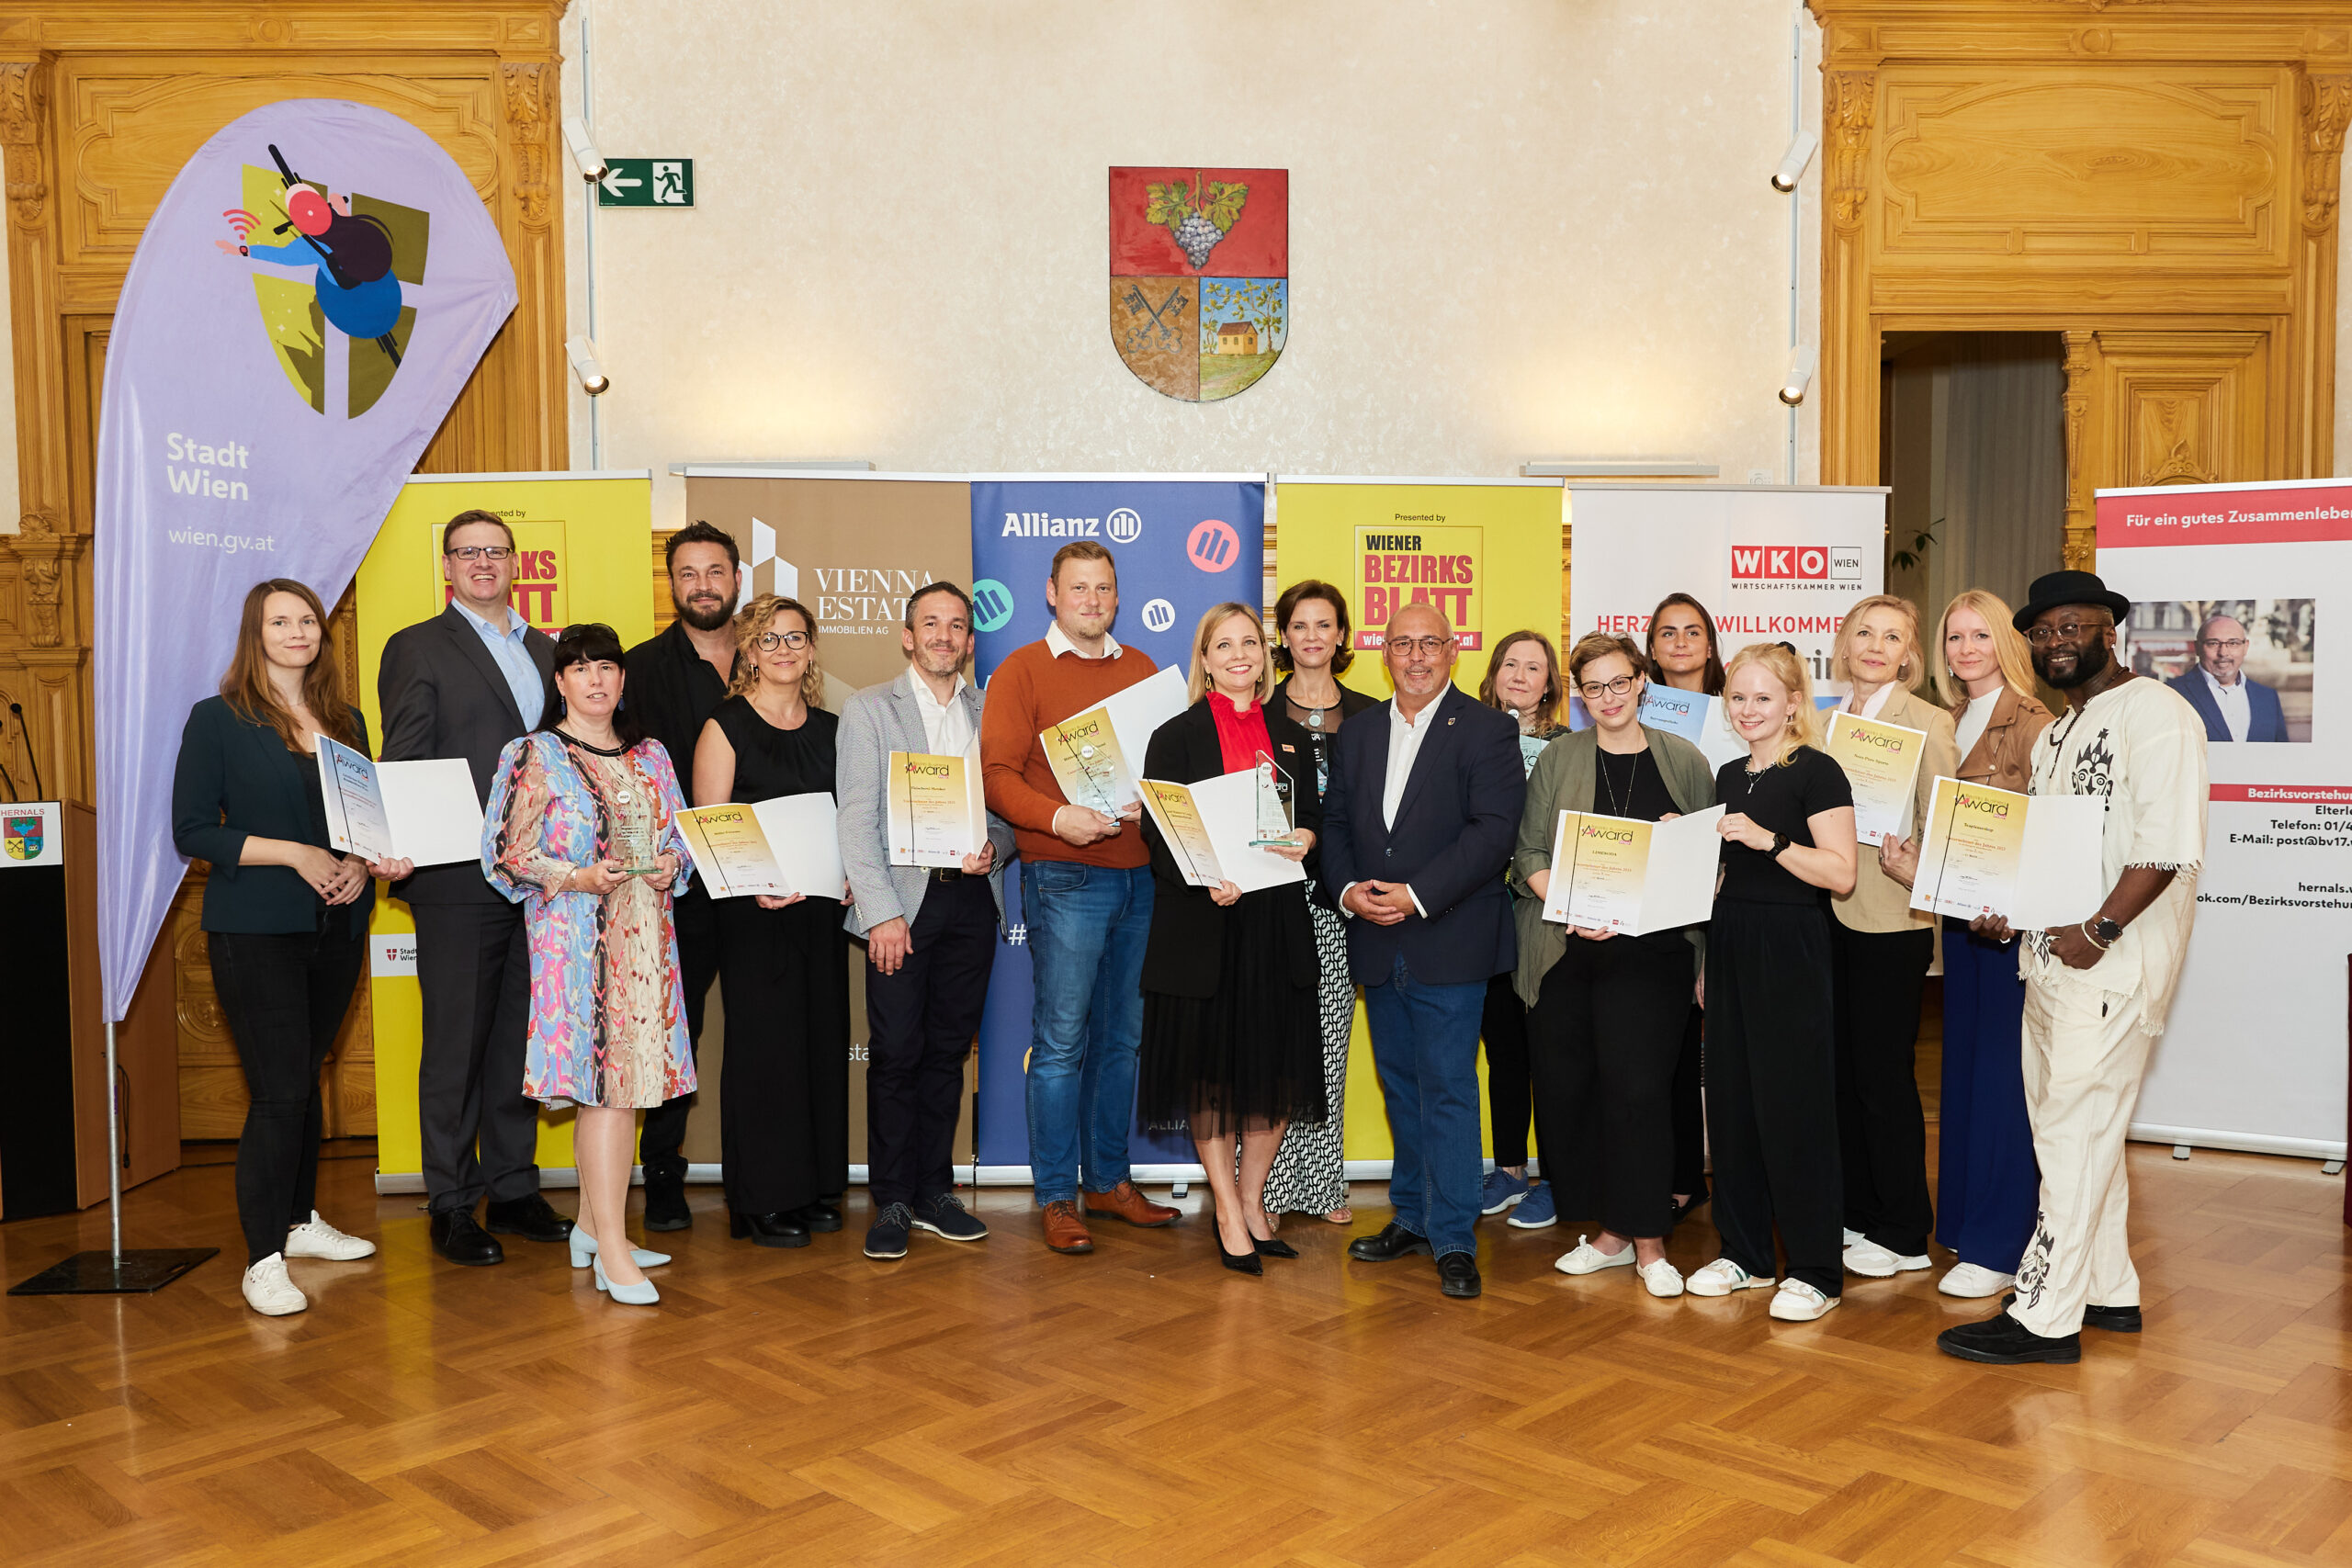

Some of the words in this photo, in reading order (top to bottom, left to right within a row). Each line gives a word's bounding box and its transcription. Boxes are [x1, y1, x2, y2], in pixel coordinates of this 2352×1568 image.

[166, 432, 249, 469] Stadt
[166, 465, 249, 501] Wien
[515, 510, 526, 519] by
[1395, 513, 1434, 522] Presented
[1436, 513, 1446, 523] by
[2126, 513, 2151, 527] Für
[2154, 513, 2177, 526] ein
[2181, 512, 2224, 529] gutes
[2228, 506, 2352, 524] Zusammenlebe
[1001, 513, 1100, 537] Allianz
[168, 525, 275, 554] wien.gv.at
[1365, 535, 1422, 551] WIENER
[1364, 554, 1474, 584] BEZIRKS
[1733, 549, 1825, 575] WKO
[1834, 558, 1860, 568] WIEN
[813, 568, 934, 593] VIENNA
[1732, 582, 1836, 591] WIRTSCHAFTSKAMMER
[816, 596, 912, 621] ESTAT
[819, 626, 873, 635] IMMOBILIEN
[876, 626, 889, 635] AG
[1715, 615, 1844, 634] WILLKOMME
[1645, 695, 1690, 714] Award
[1850, 728, 1903, 751] Award
[904, 761, 949, 776] Award
[2247, 787, 2352, 801] Bezirksvorstehu
[0, 808, 45, 817] HERNALS
[1954, 794, 2009, 817] Award
[696, 812, 743, 824] Award
[2270, 819, 2321, 830] Telefon:
[1581, 825, 1634, 842] Award
[2230, 833, 2274, 844] E-Mail:
[2277, 835, 2352, 847] post@bv17.
[2298, 882, 2352, 894] hernals.
[2197, 892, 2352, 909] ok.com/Bezirksvorstehu
